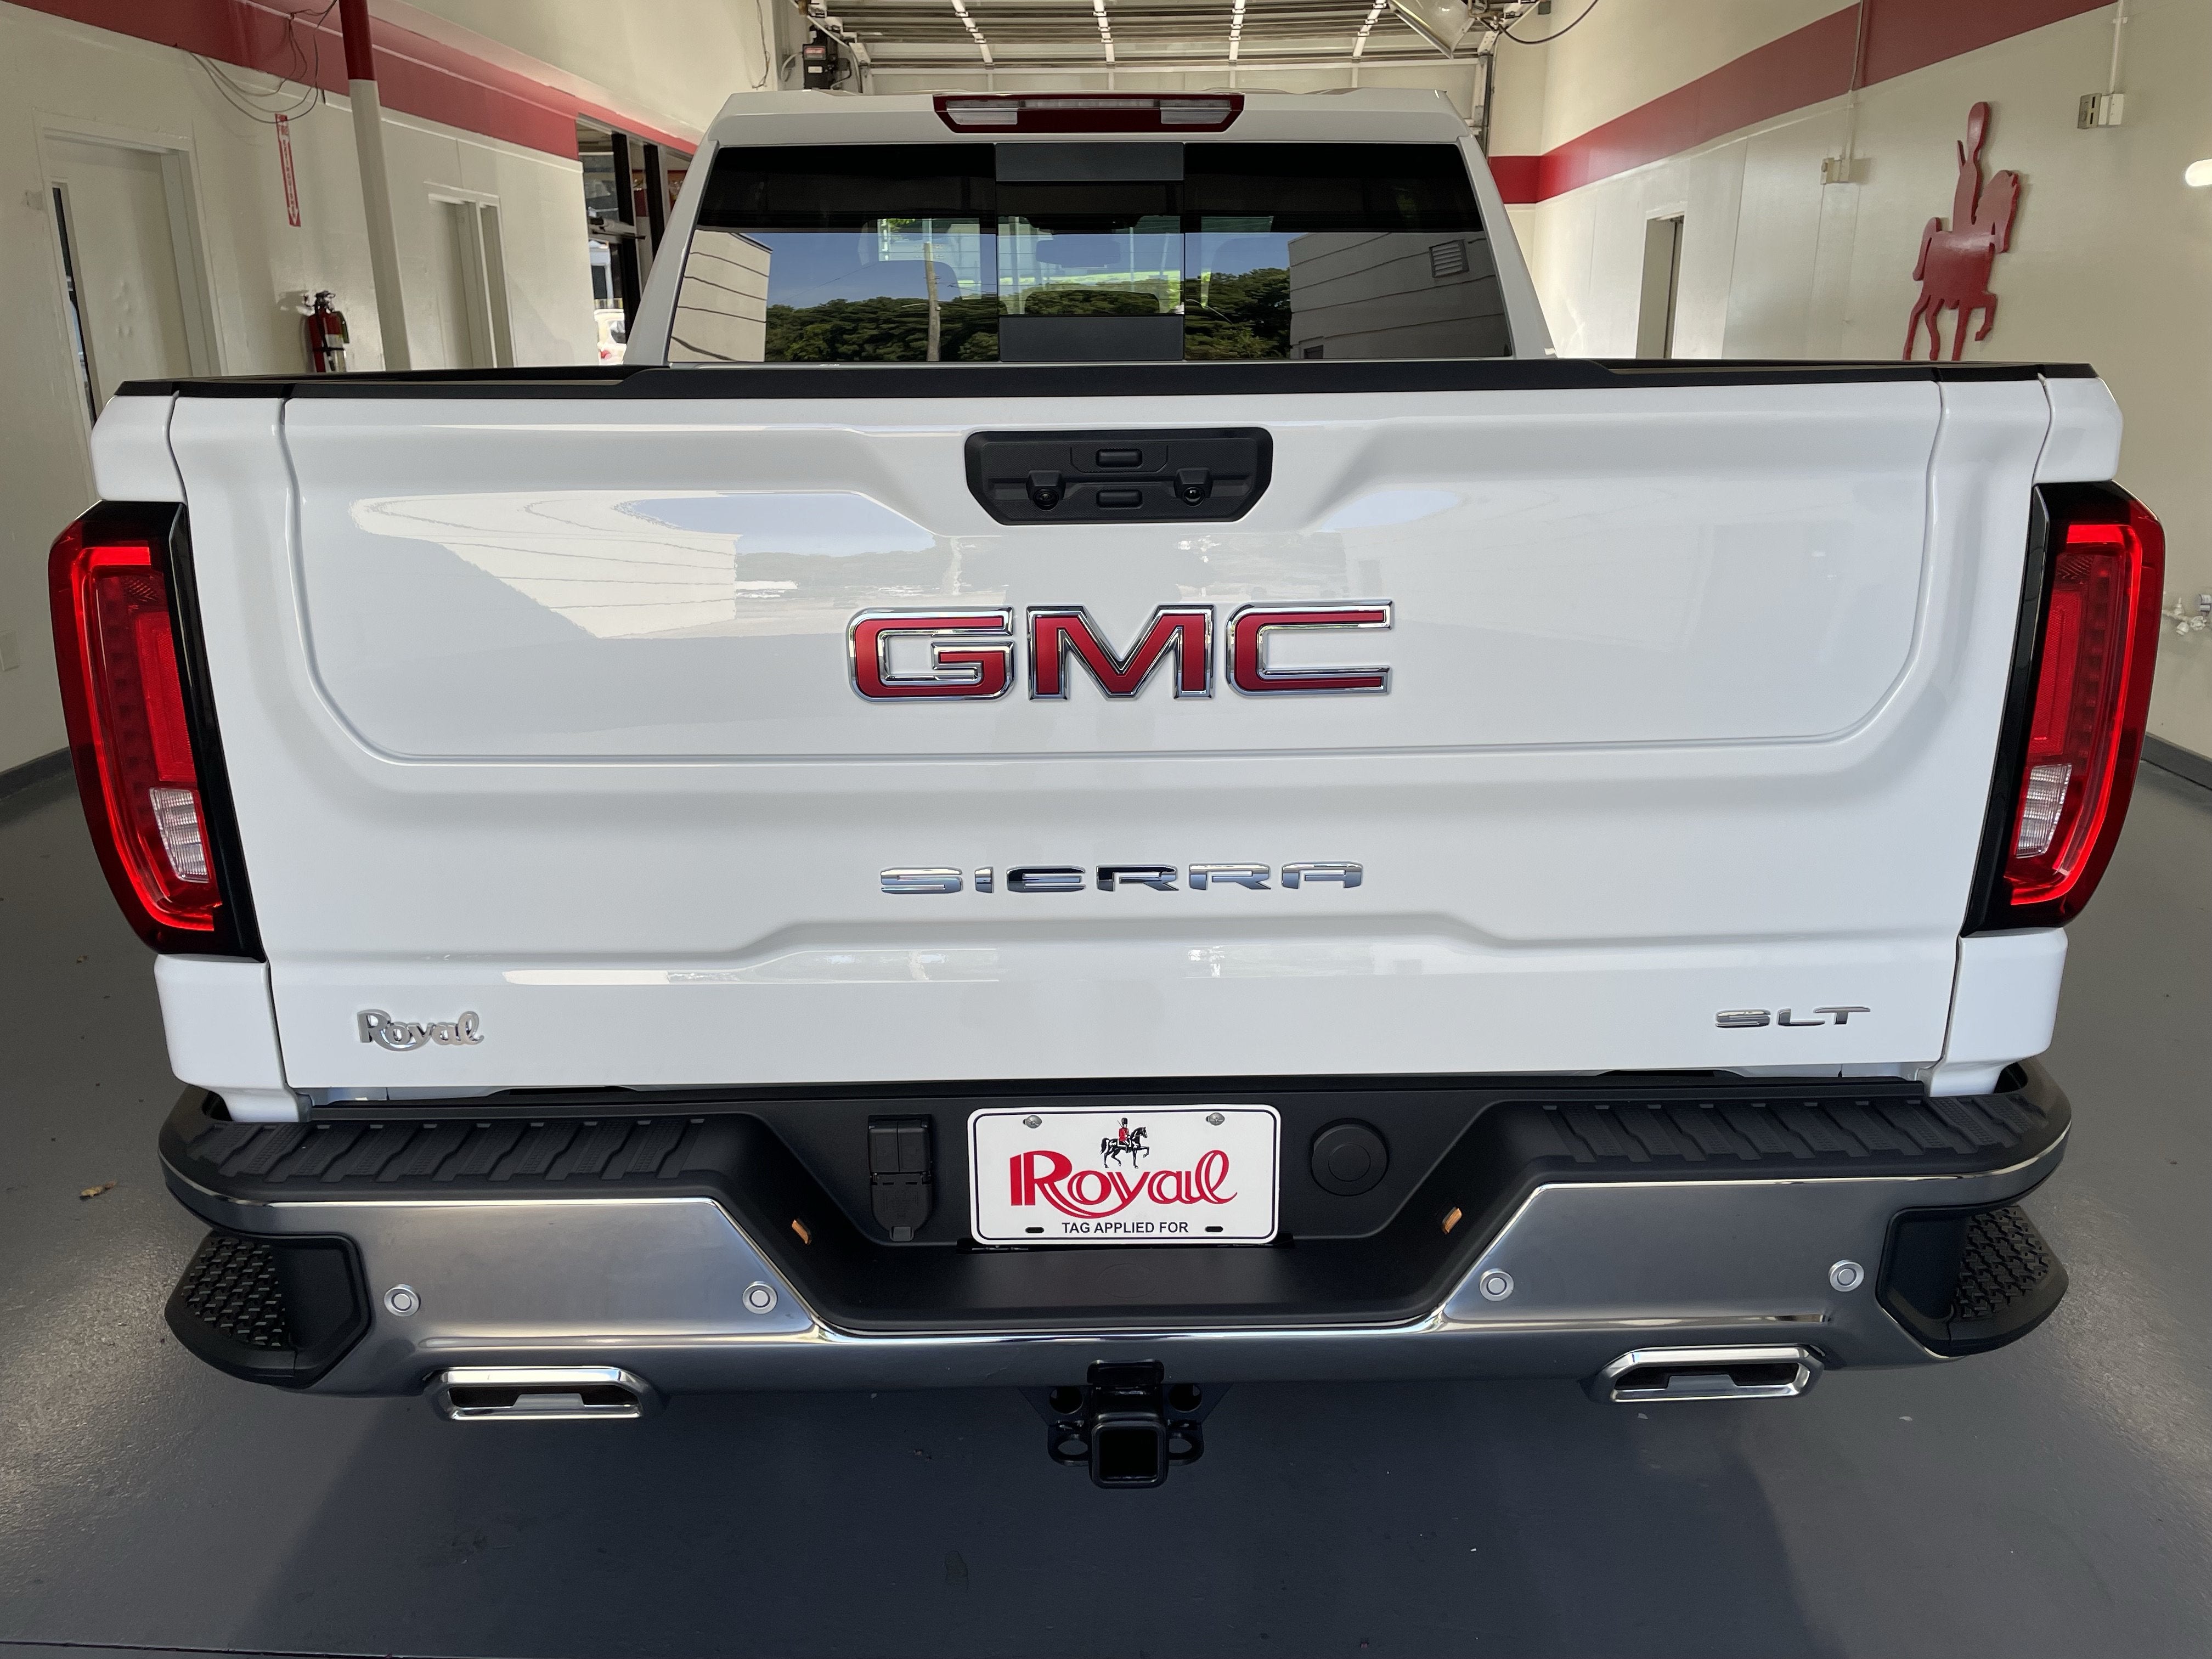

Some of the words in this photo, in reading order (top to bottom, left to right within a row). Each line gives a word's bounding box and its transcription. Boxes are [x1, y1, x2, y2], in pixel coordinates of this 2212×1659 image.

[847, 601, 1393, 701] GMC
[880, 861, 1364, 894] SIERRA
[357, 1009, 484, 1051] Royal
[1716, 1006, 1871, 1028] SLT
[1009, 1149, 1238, 1218] Royal
[1062, 1222, 1090, 1233] TAG
[1094, 1222, 1154, 1233] APPLIED
[1159, 1222, 1188, 1233] FOR
